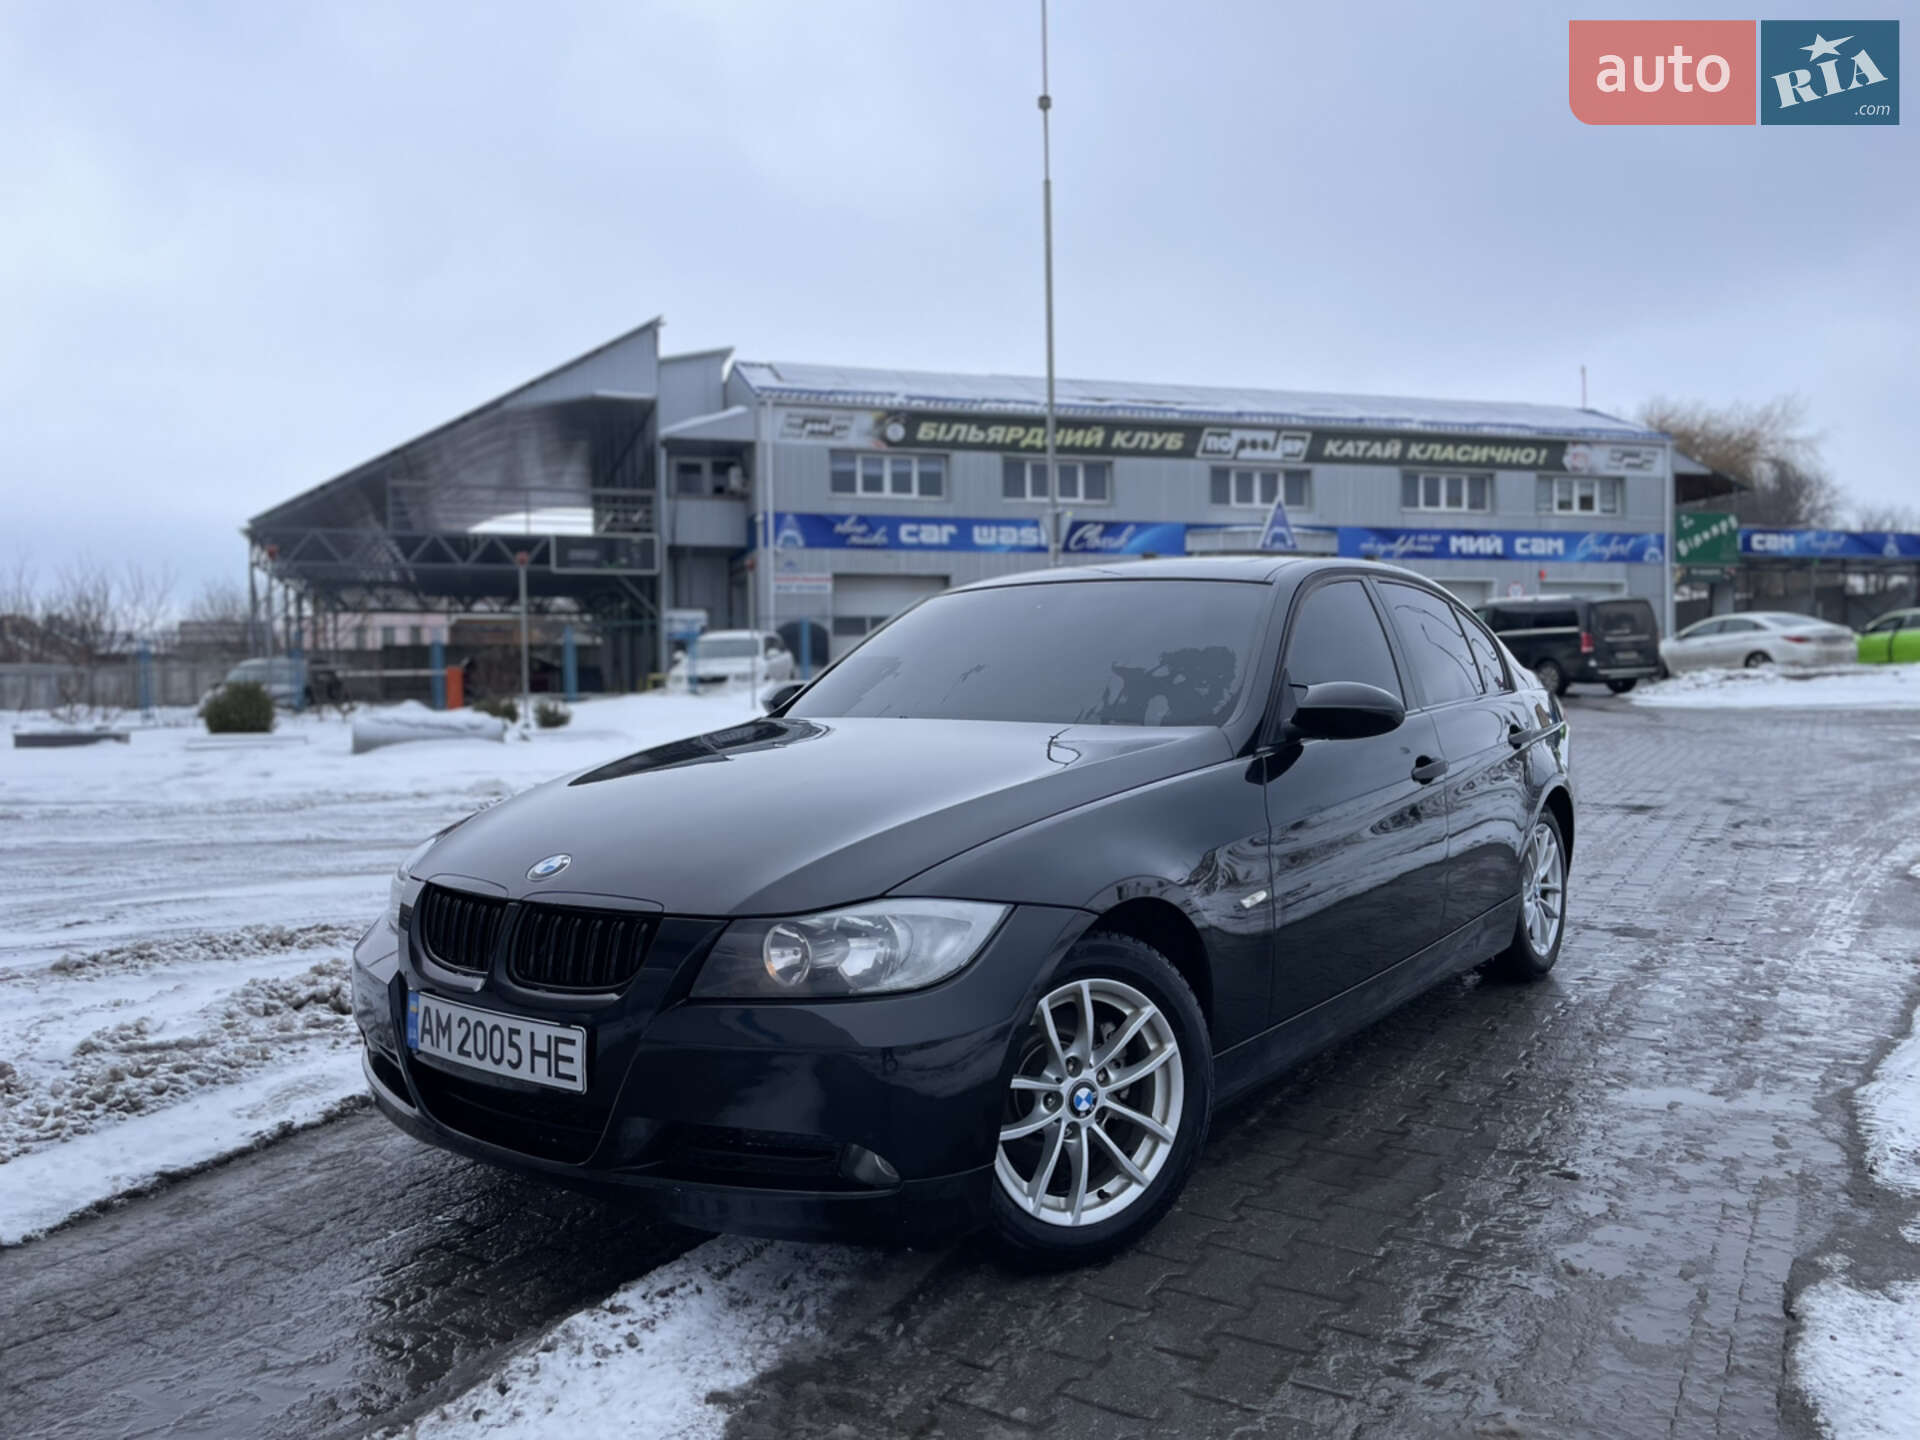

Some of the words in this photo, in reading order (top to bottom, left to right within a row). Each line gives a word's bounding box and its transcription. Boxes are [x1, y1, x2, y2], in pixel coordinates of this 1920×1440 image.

[1111, 430, 1185, 450] КЛУБ
[1323, 438, 1403, 460] КАТАЙ
[1407, 443, 1547, 466] КЛАСИЧНО!
[899, 524, 958, 545] car
